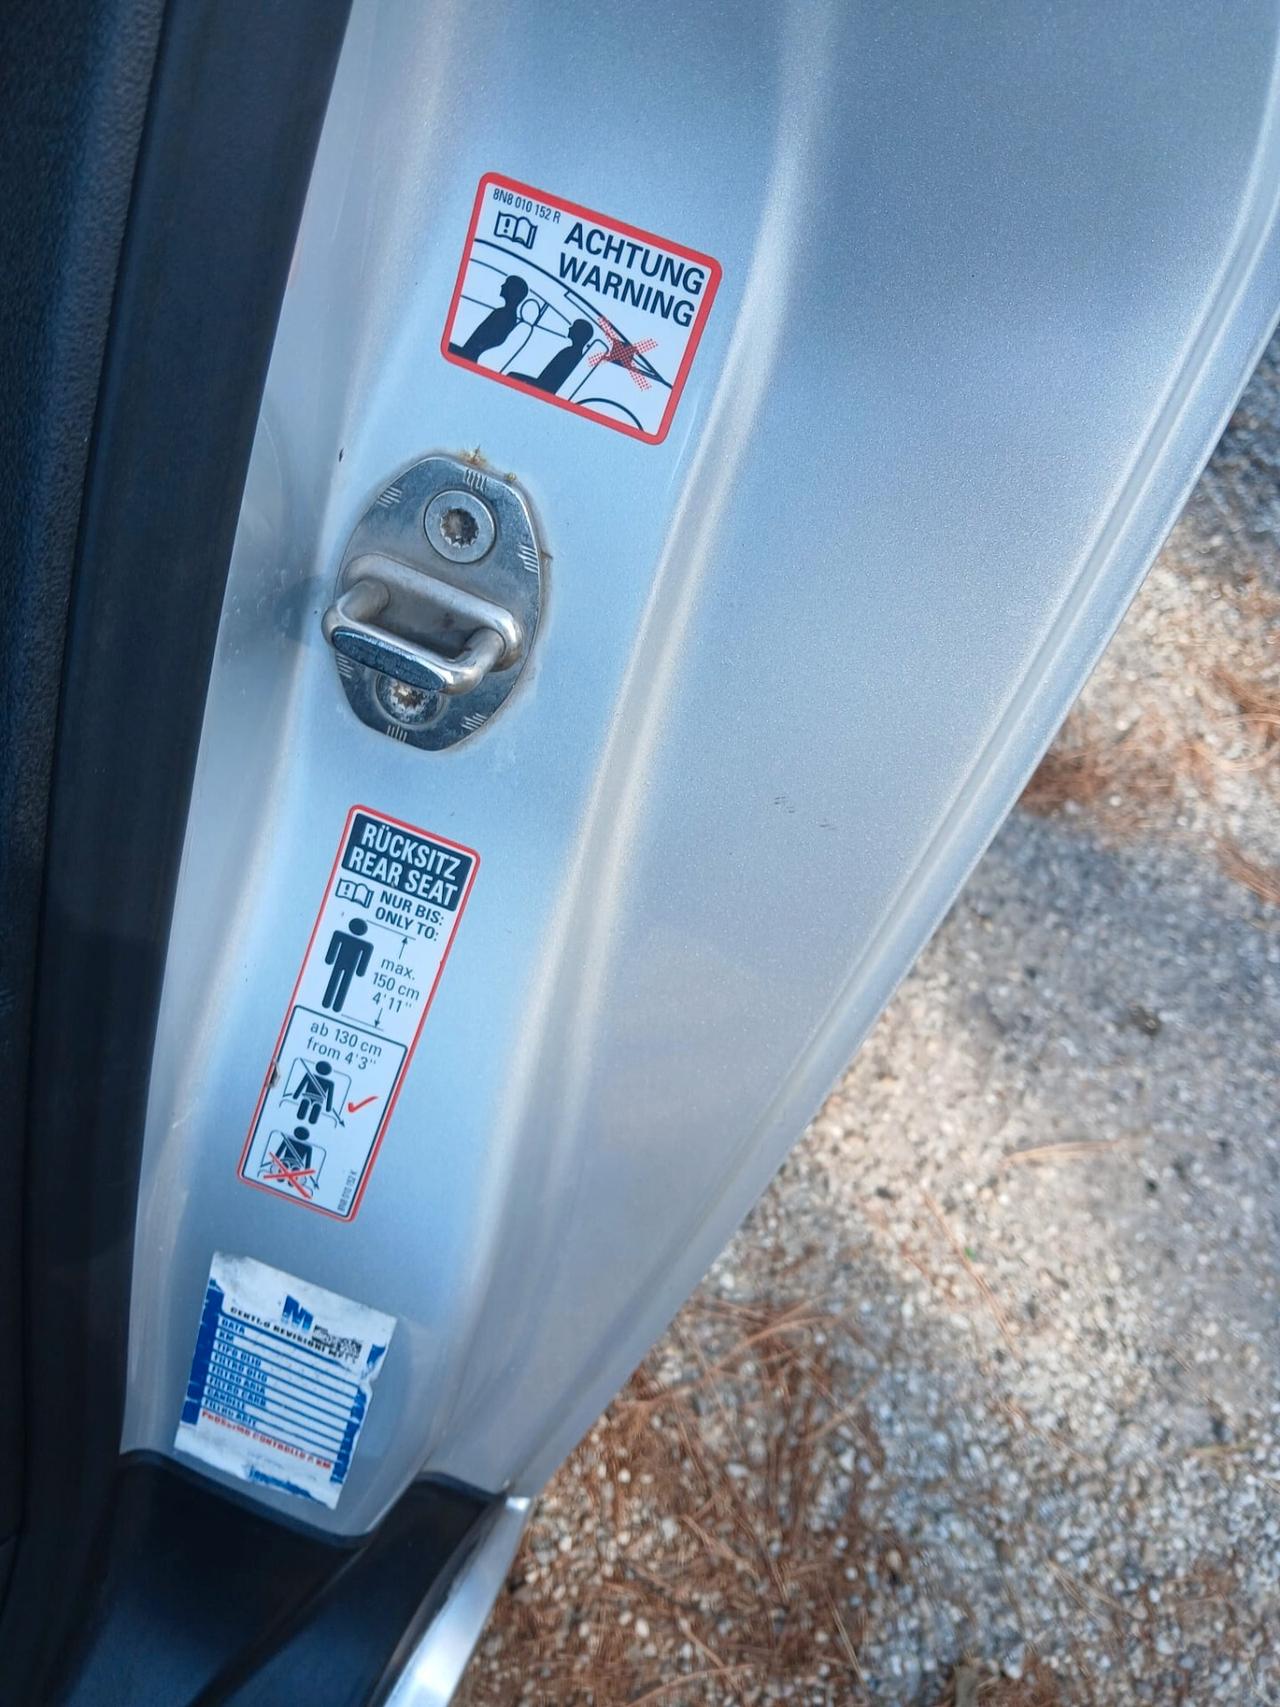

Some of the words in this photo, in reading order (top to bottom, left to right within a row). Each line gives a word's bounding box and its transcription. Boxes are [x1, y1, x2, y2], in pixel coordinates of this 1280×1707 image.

[493, 188, 514, 206] 8N8
[515, 196, 532, 213] 010
[534, 204, 551, 221] 152
[553, 211, 561, 224] R
[564, 222, 705, 295] ACHTUNG
[559, 252, 695, 328] WARNING
[361, 822, 461, 881] RÜCKSITZ
[348, 846, 403, 887] REAR
[404, 869, 458, 906] SEAT
[375, 907, 414, 930] ONLY
[417, 921, 439, 942] TO:
[380, 890, 412, 913] NUR
[415, 904, 444, 926] BIS:
[372, 972, 396, 992] 150
[397, 984, 420, 1001] cm
[380, 958, 415, 981] max.
[306, 1036, 341, 1061] from
[310, 1022, 328, 1037] ab
[335, 1028, 358, 1048] 130
[360, 1041, 382, 1057] cm
[220, 1330, 234, 1341] KM
[221, 1319, 245, 1334] DATA
[241, 1353, 261, 1367] OLIO
[247, 1367, 267, 1382] OLIO
